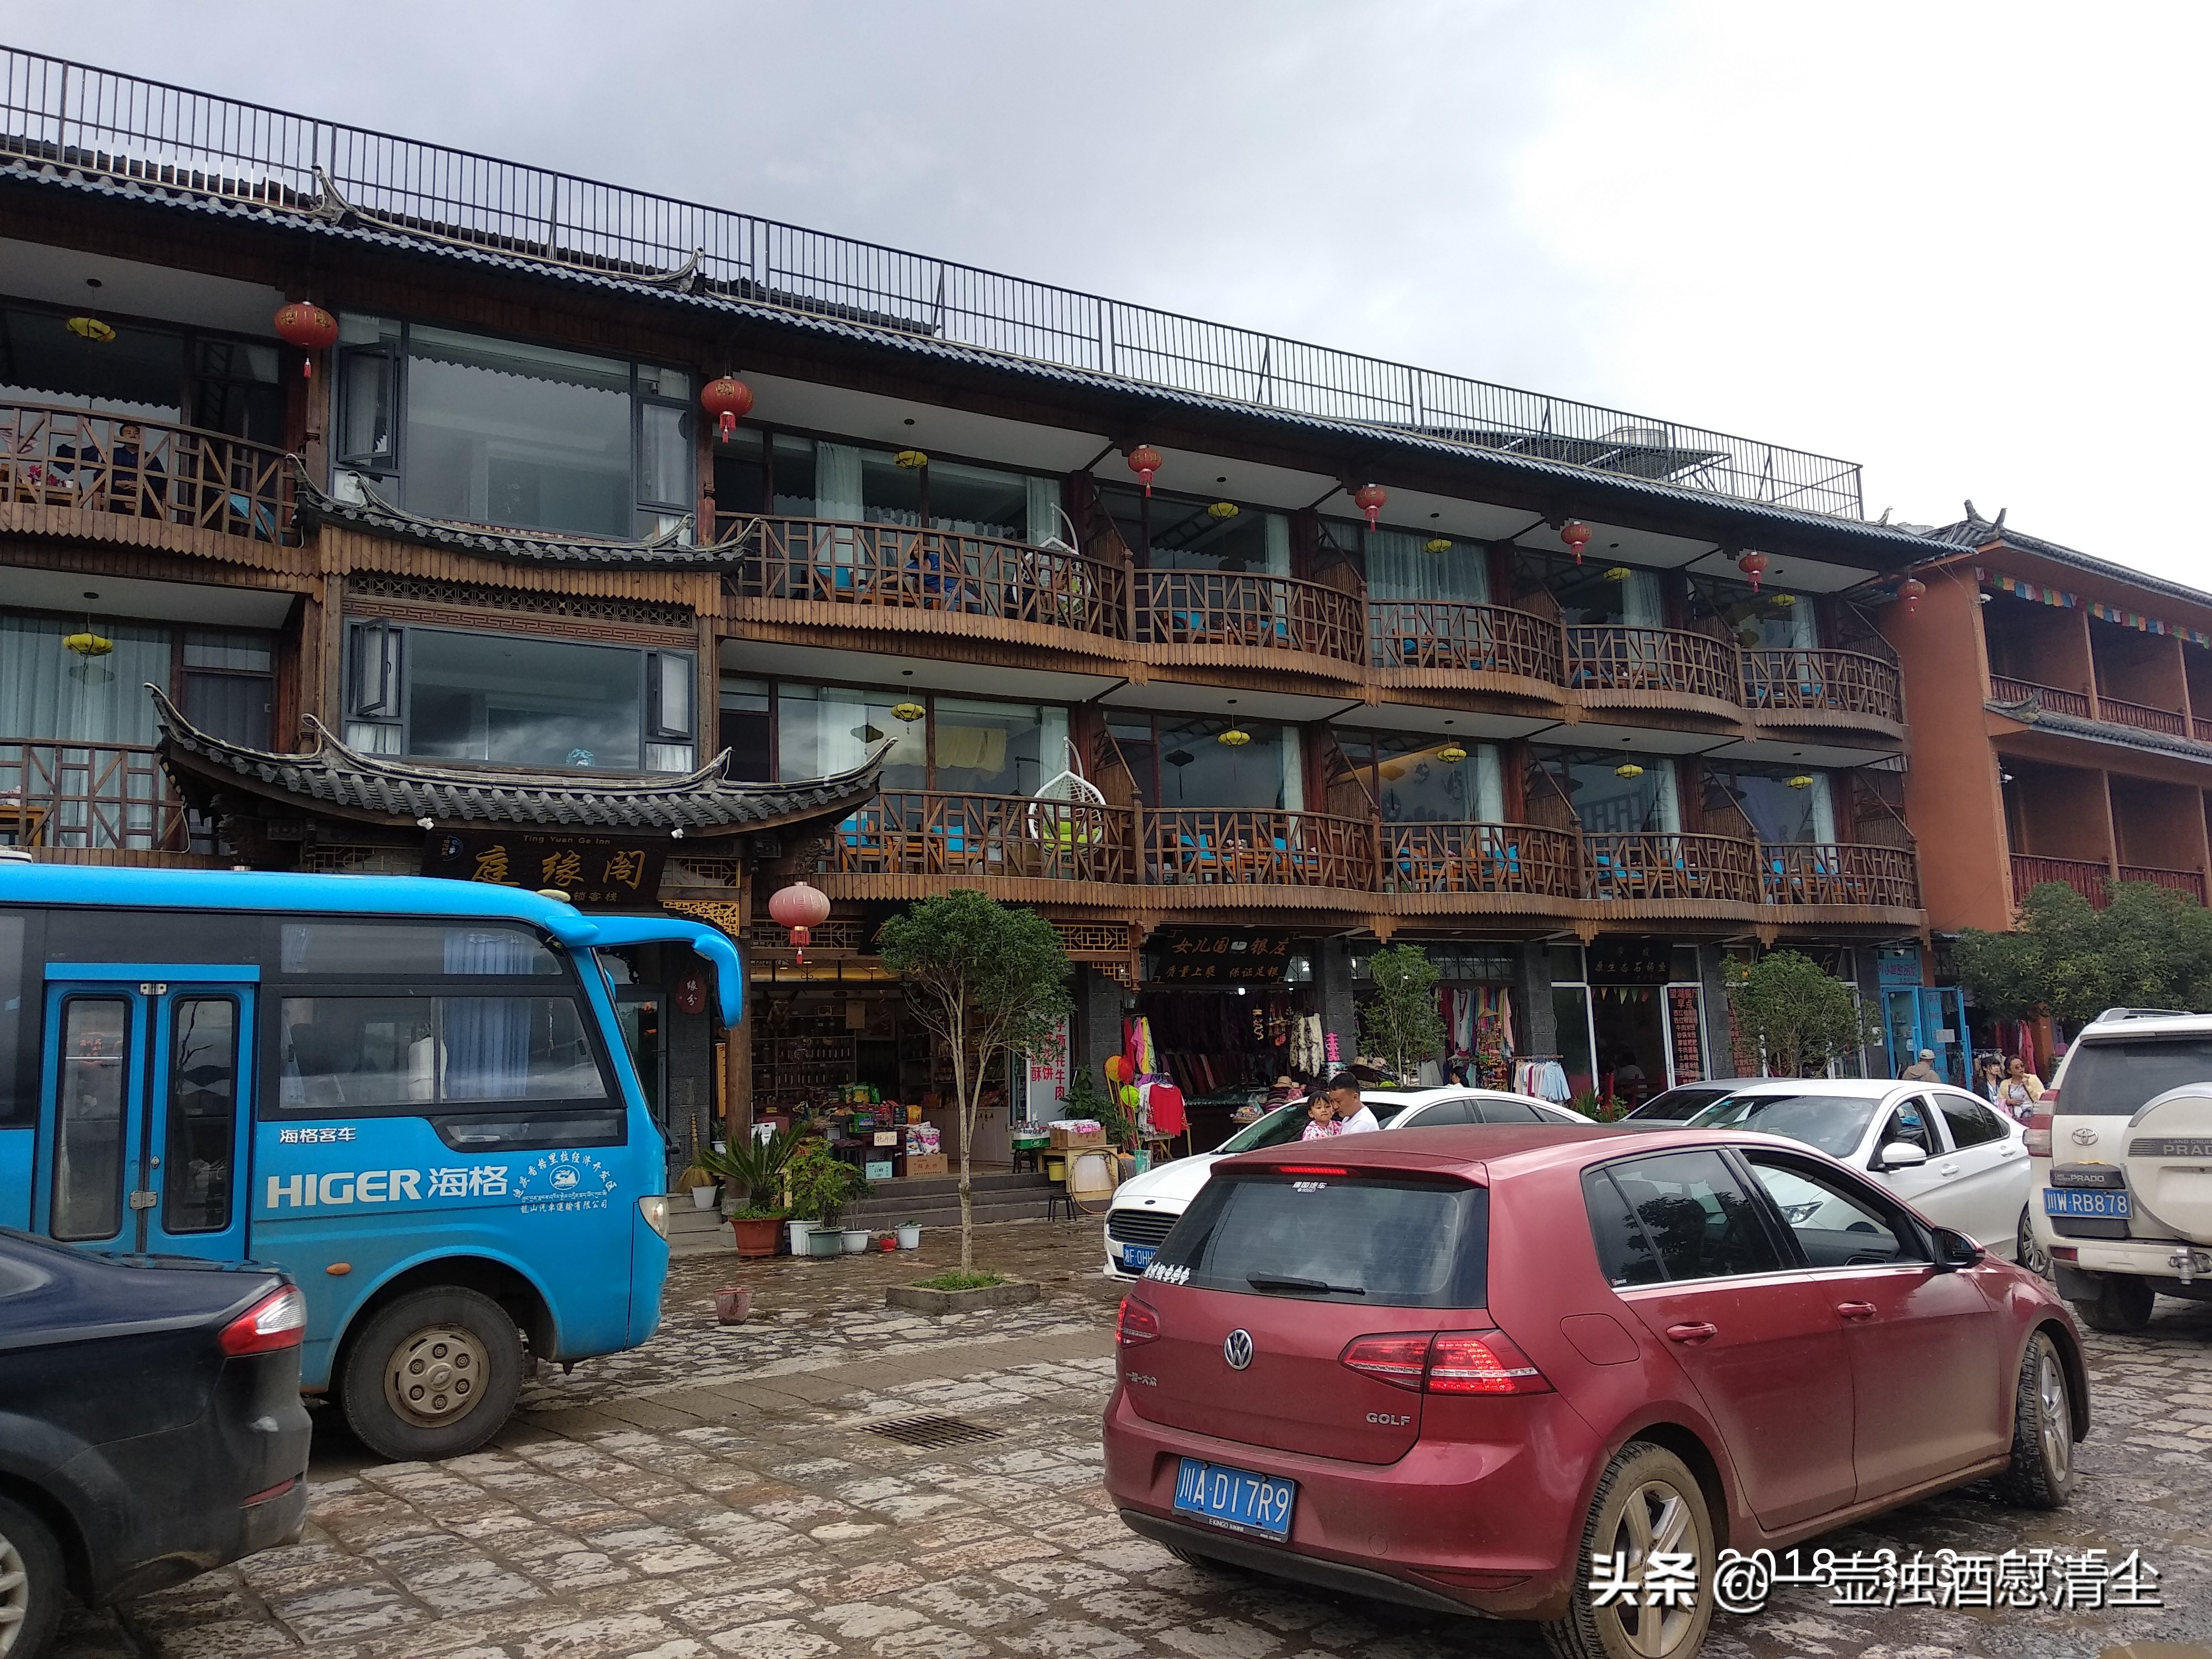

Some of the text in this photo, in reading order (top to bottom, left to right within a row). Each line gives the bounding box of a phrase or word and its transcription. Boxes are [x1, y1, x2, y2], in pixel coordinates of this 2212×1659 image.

[524, 835, 544, 843] Ting
[573, 891, 617, 902] 锁客栈
[1172, 937, 1289, 956] 女儿国银庄
[280, 1126, 356, 1144] 海格客车
[267, 1165, 508, 1208] HIGER 海格
[1365, 1412, 1411, 1426] GOLF
